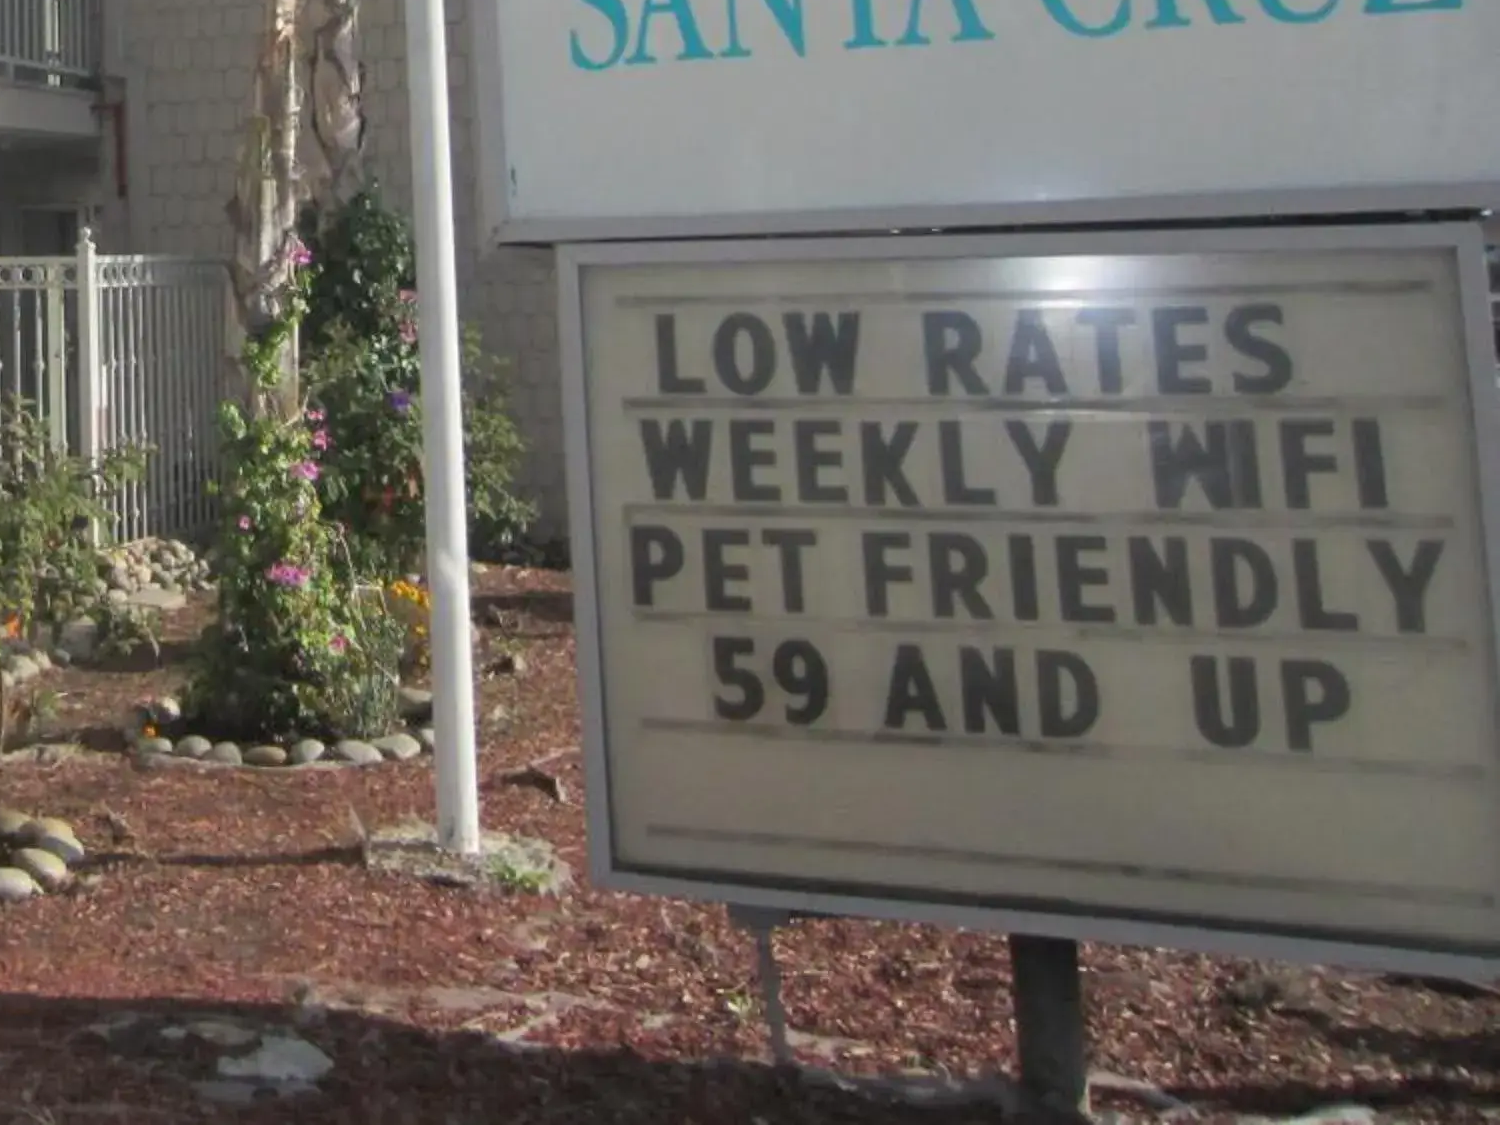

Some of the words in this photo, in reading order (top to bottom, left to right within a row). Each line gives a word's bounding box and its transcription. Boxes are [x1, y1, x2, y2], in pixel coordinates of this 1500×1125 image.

[655, 311, 860, 395] LOW
[922, 304, 1295, 395] RATES
[640, 418, 1074, 507] WEEKLY
[1149, 419, 1390, 509] WIFI
[631, 526, 817, 614] PET
[862, 533, 1445, 634] FRIENDLY
[713, 637, 829, 725] 59
[883, 644, 1100, 739] AND
[1190, 656, 1352, 751] UP
